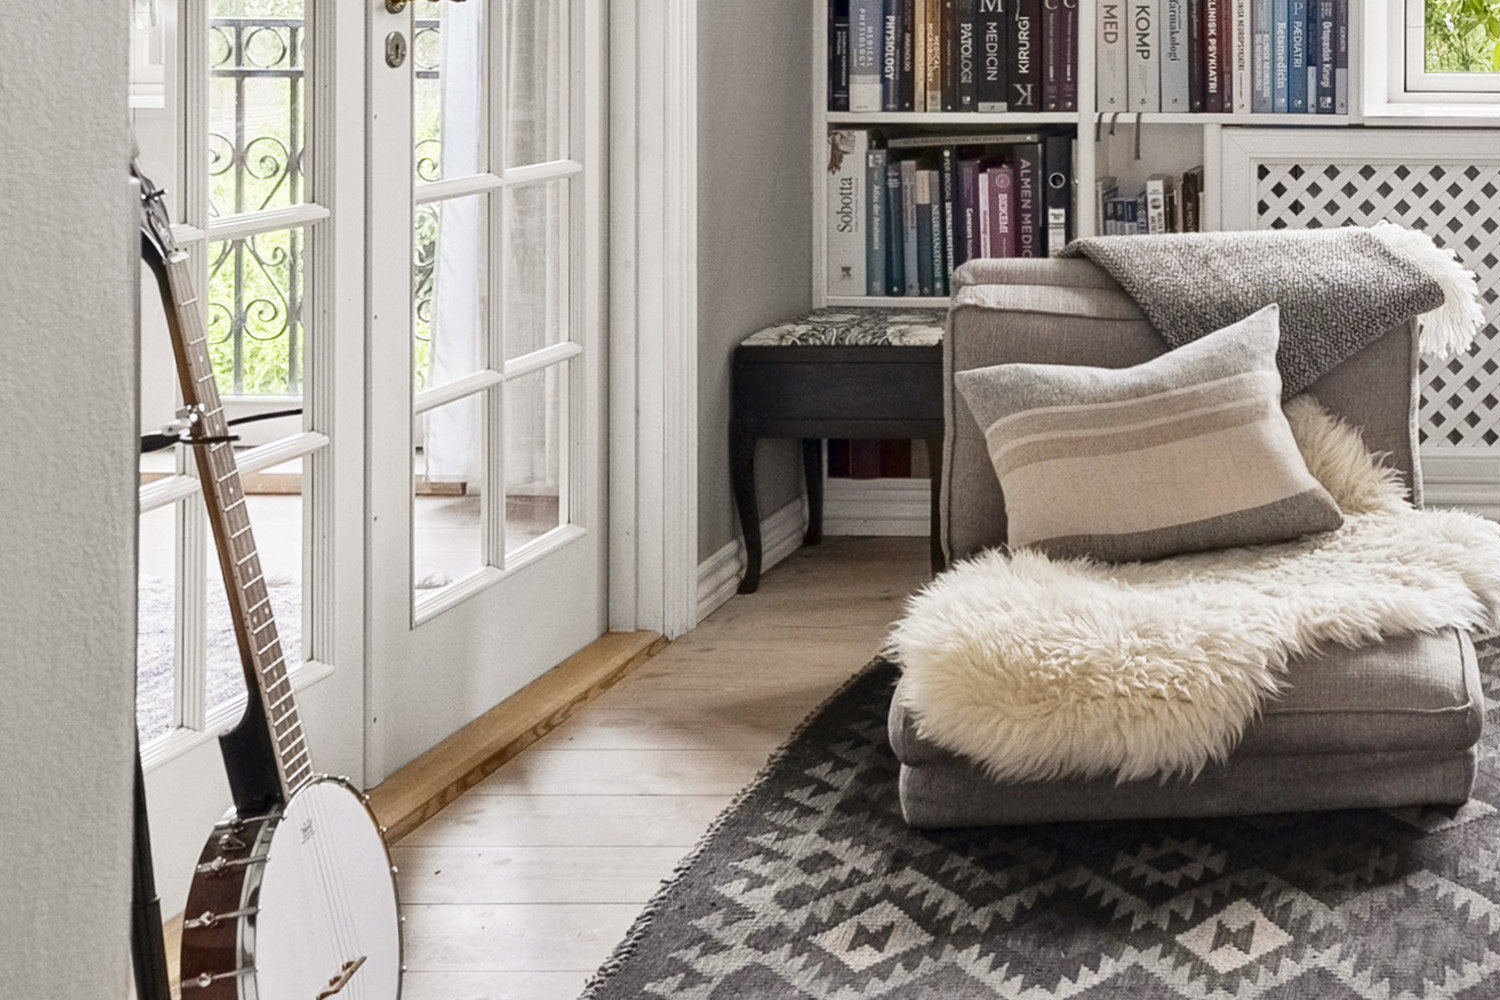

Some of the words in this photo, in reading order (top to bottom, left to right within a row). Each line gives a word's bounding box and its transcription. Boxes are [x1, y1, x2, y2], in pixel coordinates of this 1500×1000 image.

[858, 8, 866, 67] PHYSIOLOGY
[866, 26, 874, 68] MEDICAL
[885, 15, 897, 81] PHYSIOLOGY
[1017, 16, 1030, 74] KIRURGI
[1103, 4, 1118, 44] MED
[1135, 5, 1150, 60] KOMP
[1167, 0, 1181, 61] farmakologi
[1293, 20, 1304, 68] PÆDIATRI
[1320, 21, 1333, 62] Ortopædisk
[926, 23, 934, 83] MICROBIOLOGY
[960, 23, 973, 84] PATOLOGI
[986, 22, 998, 82] MEDICIN
[1208, 38, 1218, 93] PSYKIATRI
[1276, 22, 1288, 89] Retsmedicin
[1320, 63, 1333, 88] Kirurgi
[1012, 83, 1034, 106] K
[837, 177, 853, 233] Sobotta
[873, 184, 881, 203] Atlas
[873, 204, 881, 216] der
[1020, 158, 1033, 210] ALMEN
[873, 217, 881, 250] Anatomie
[998, 192, 1009, 234] BIOKEMI
[931, 204, 942, 278] NEUROANATOMI
